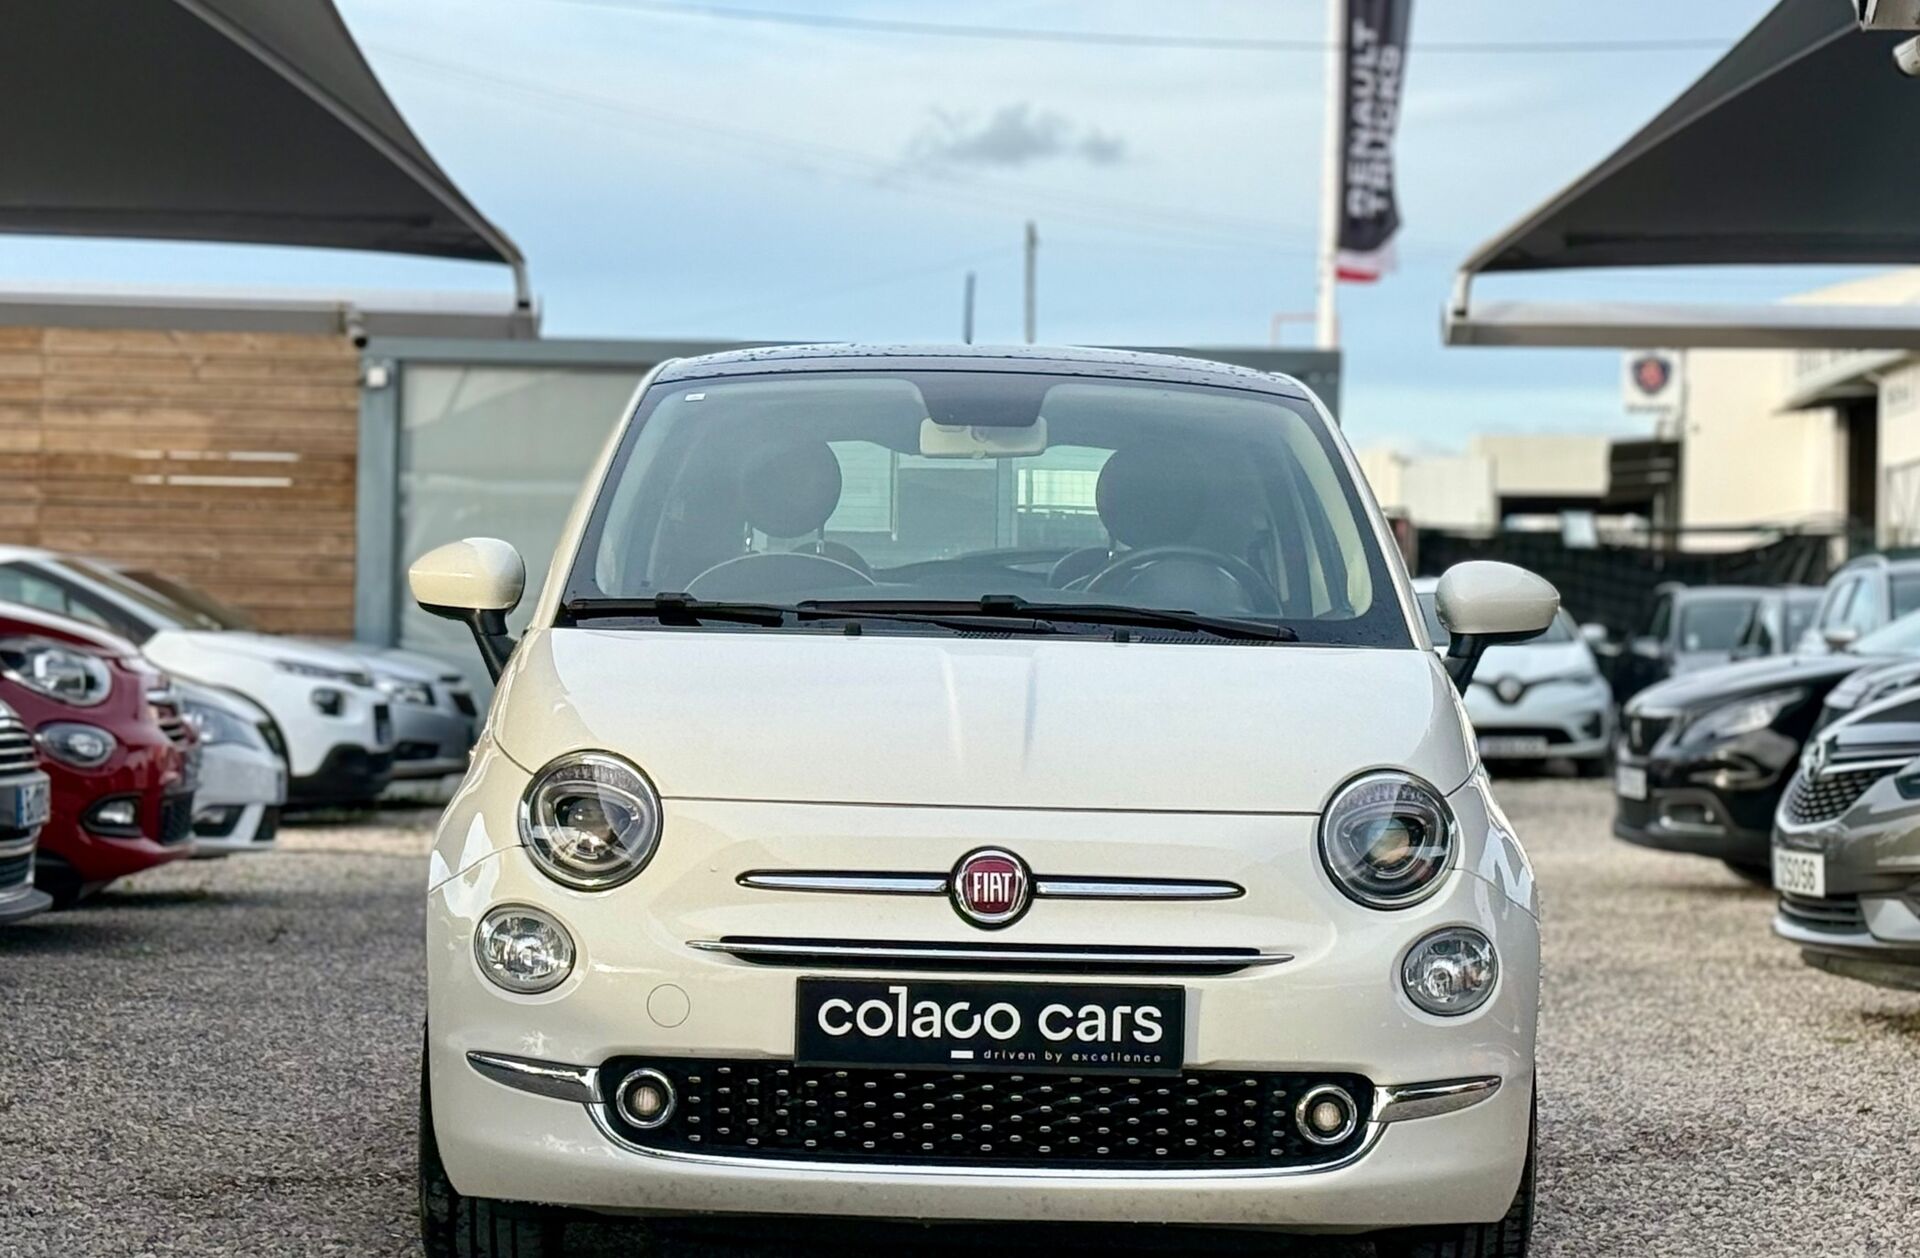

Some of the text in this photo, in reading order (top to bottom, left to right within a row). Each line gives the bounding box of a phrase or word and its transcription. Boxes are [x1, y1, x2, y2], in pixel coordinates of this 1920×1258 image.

[973, 872, 1013, 903] FIAT
[1037, 1003, 1164, 1043] cars
[983, 1049, 1162, 1063] driven by excellence
